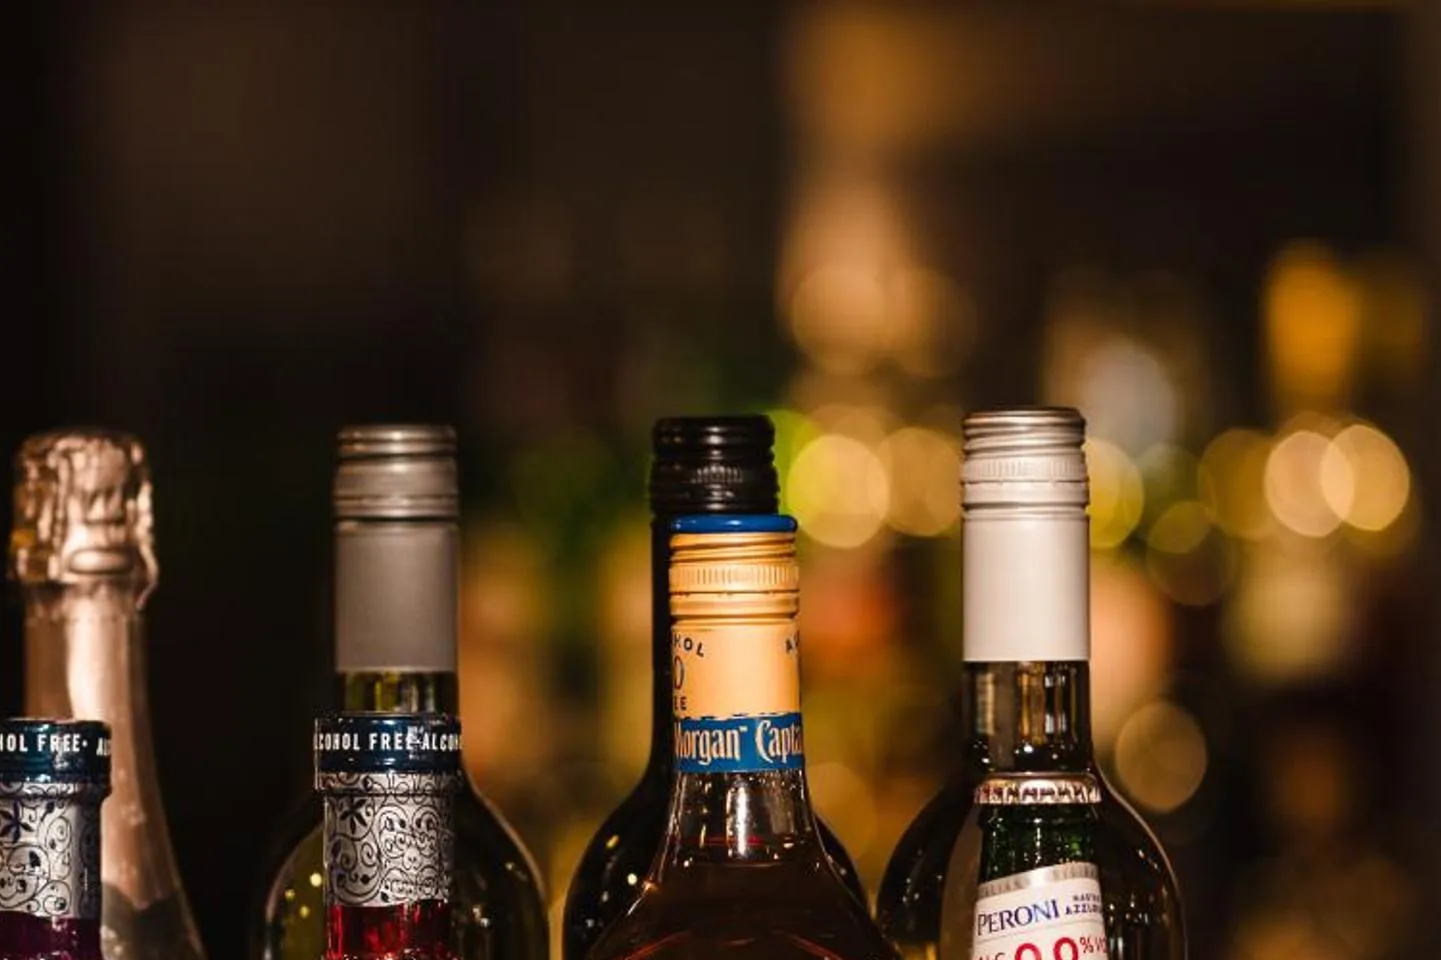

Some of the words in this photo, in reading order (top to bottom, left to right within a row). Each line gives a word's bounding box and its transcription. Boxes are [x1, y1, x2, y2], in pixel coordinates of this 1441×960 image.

[37, 733, 81, 752] FREE
[369, 732, 415, 750] FREE
[977, 899, 1060, 936] PERONI
